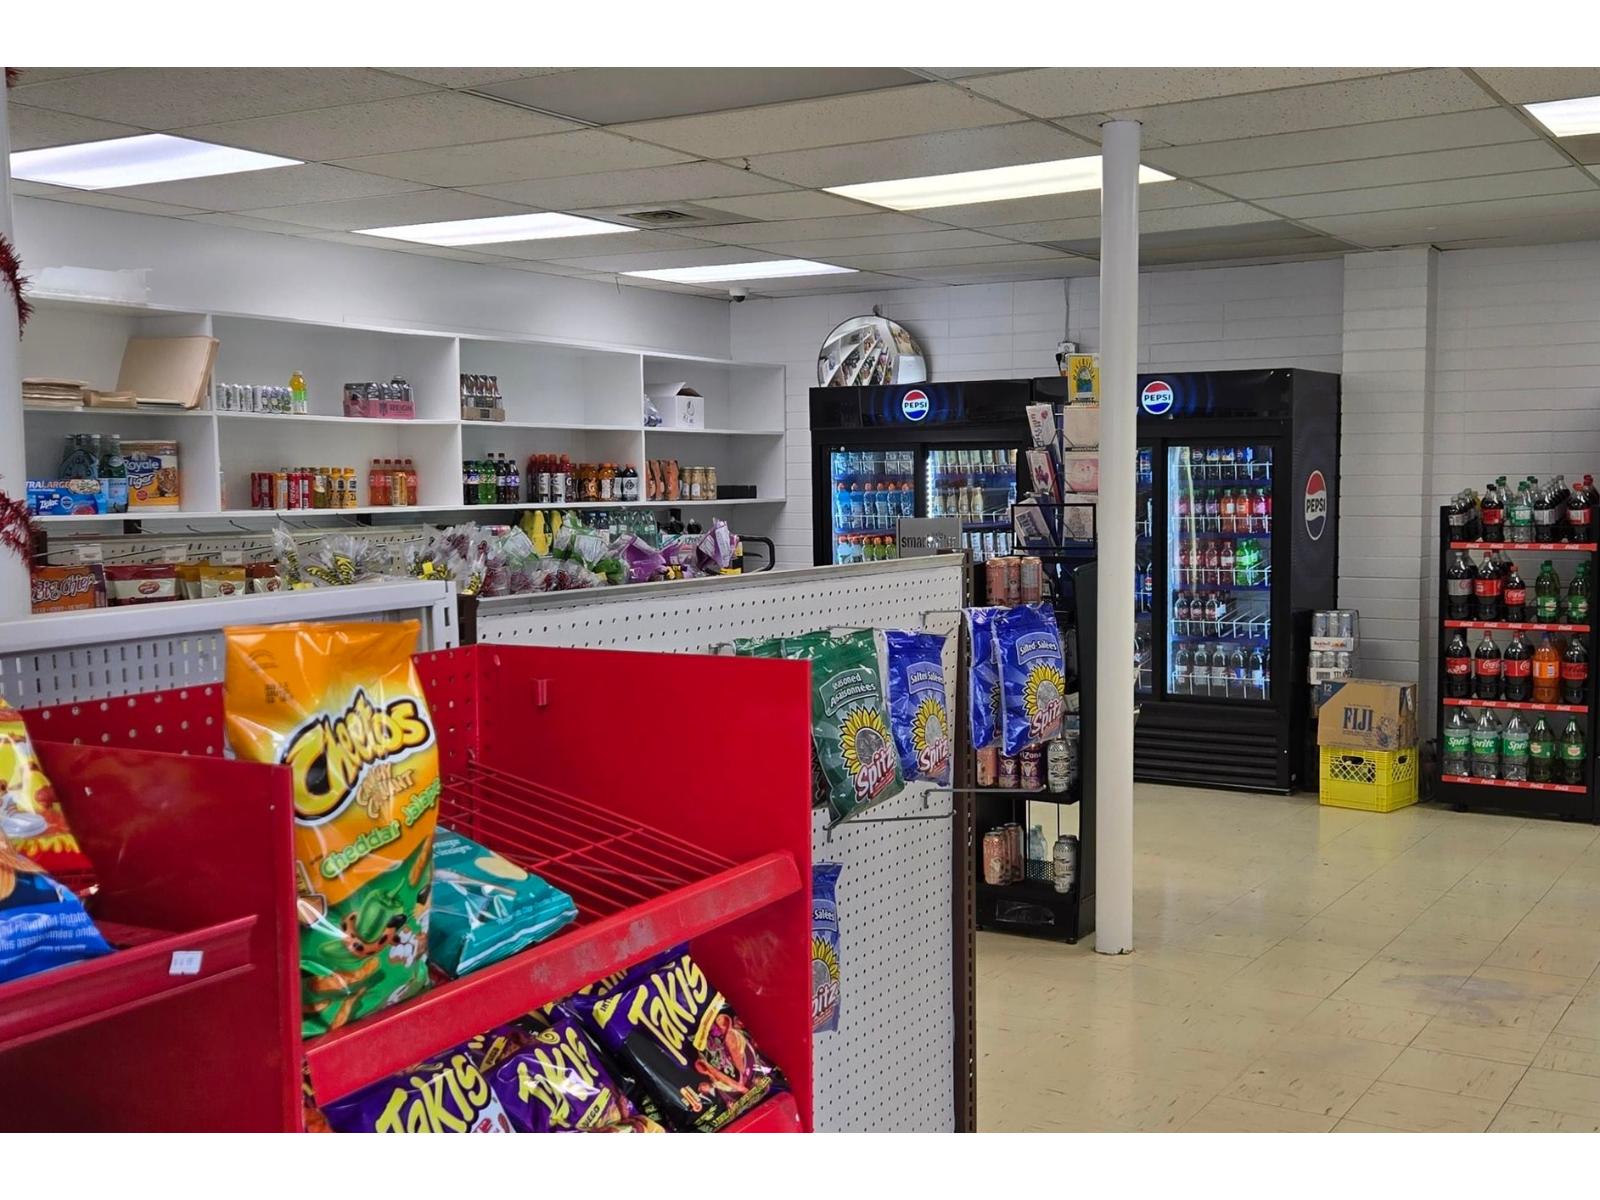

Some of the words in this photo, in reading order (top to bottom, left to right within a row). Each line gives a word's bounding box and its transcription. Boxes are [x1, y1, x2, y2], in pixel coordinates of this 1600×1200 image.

[1144, 394, 1171, 402] PEPSI
[128, 473, 157, 490] Tiger
[1306, 497, 1326, 513] PEPSI
[1020, 642, 1036, 656] Salted
[1343, 707, 1374, 731] FIJI
[280, 689, 431, 821] Cheetos
[856, 741, 896, 800] Spitz
[918, 738, 949, 773] Spitz
[321, 819, 401, 879] Cheddar
[628, 955, 708, 1066] Takis
[376, 1055, 488, 1133] Takis
[517, 1027, 599, 1127] Takis
